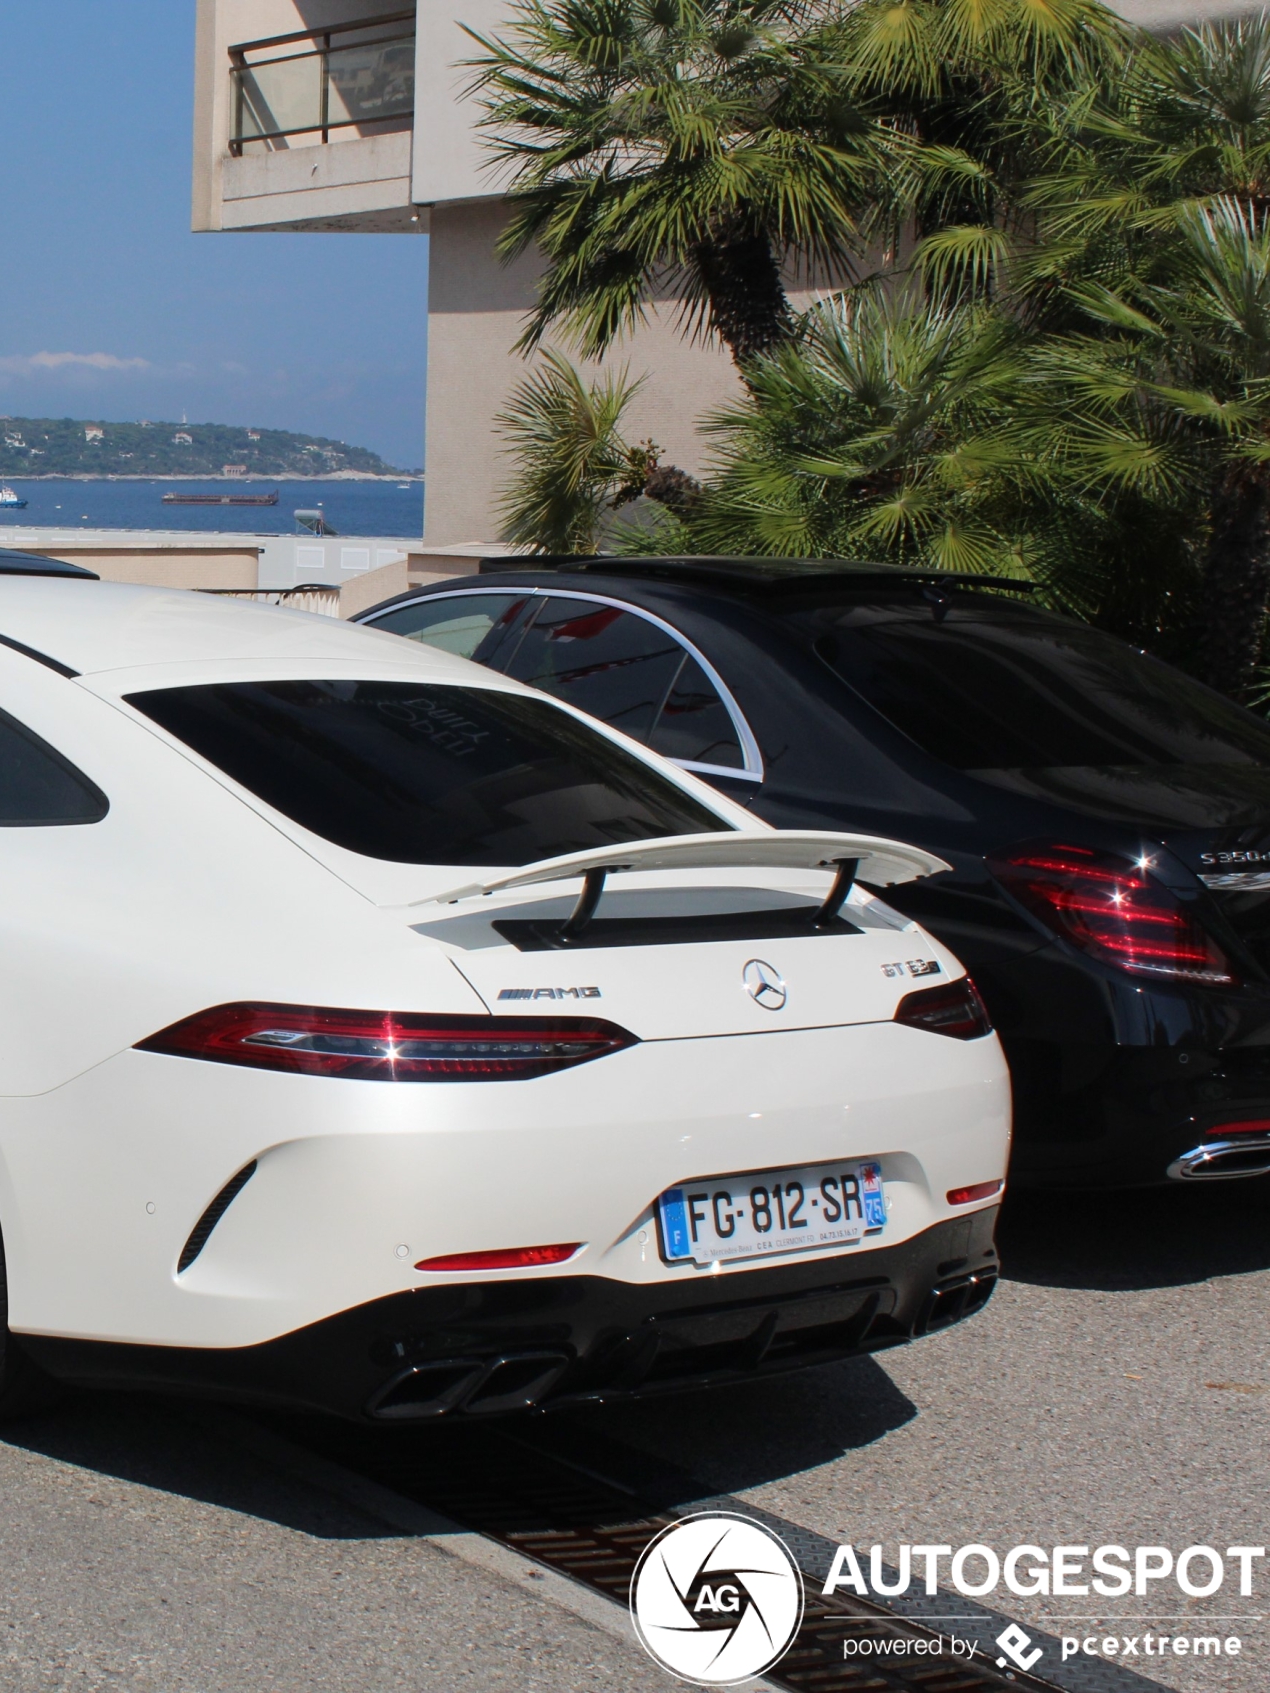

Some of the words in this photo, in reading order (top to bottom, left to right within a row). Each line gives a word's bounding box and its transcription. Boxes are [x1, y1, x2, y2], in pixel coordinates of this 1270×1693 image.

[880, 962, 905, 978] GT
[532, 986, 602, 1000] AMG
[673, 1230, 682, 1245] F
[775, 1234, 806, 1247] CLERMONT
